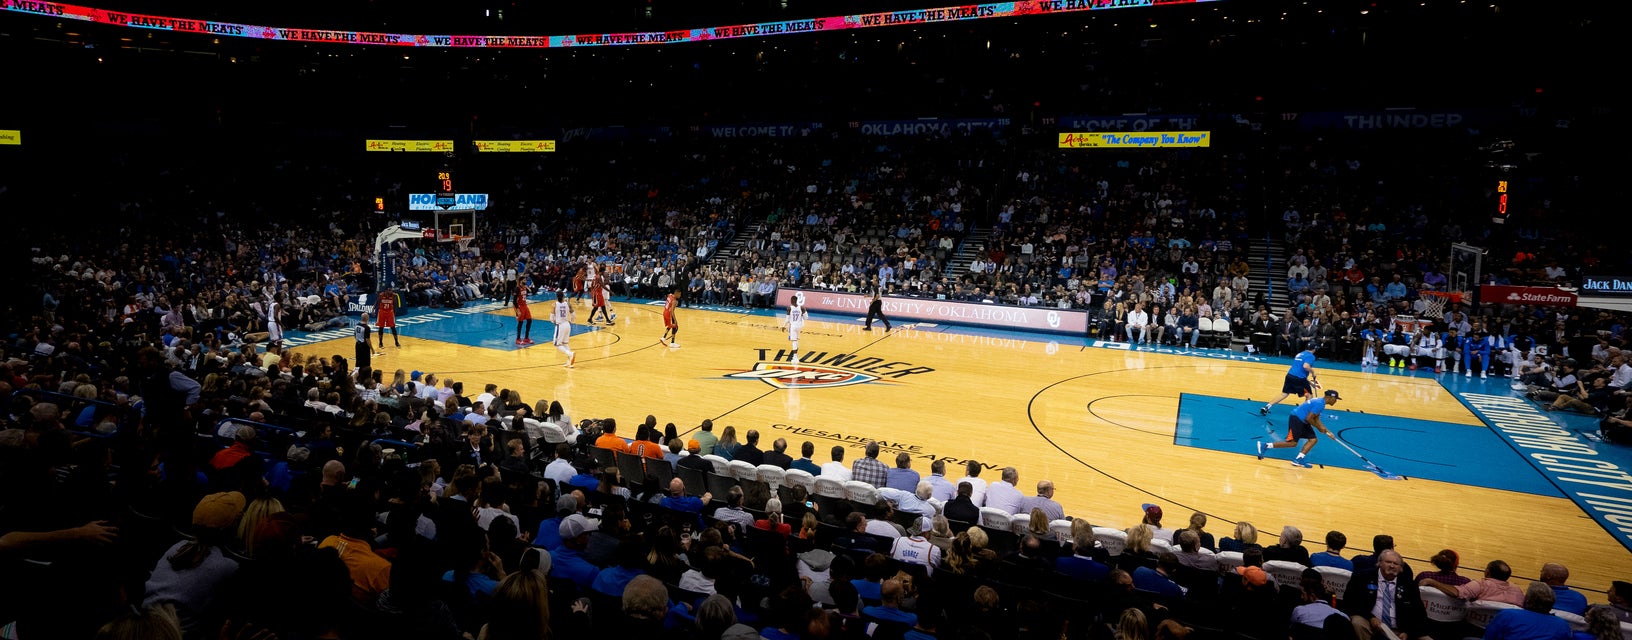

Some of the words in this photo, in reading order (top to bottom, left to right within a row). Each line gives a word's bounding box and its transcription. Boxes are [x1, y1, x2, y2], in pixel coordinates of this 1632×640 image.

[107, 11, 128, 25] WE
[131, 15, 167, 29] HAVE
[167, 19, 195, 31] THE
[199, 21, 243, 35] MEATS
[862, 14, 882, 26] WE
[884, 11, 918, 25] HAVE
[918, 8, 946, 22] THE
[948, 5, 996, 20] MEATS
[279, 29, 299, 40] WE
[301, 31, 333, 41] HAVE
[334, 32, 357, 43] THE
[359, 33, 400, 45] MEATS
[714, 27, 731, 39] WE
[732, 25, 760, 38] HAVE
[761, 23, 783, 34] THE
[785, 19, 825, 33] MEATS
[433, 36, 451, 46] WE
[453, 37, 484, 47] HAVE
[484, 37, 505, 47] THE
[507, 37, 545, 47] MEATS
[577, 35, 594, 46] WE
[596, 34, 625, 45] HAVE
[624, 33, 645, 45] THE
[648, 31, 684, 44] MEATS
[1345, 113, 1463, 129] THUNDER
[1122, 132, 1160, 147] Company
[1160, 131, 1176, 143] You
[443, 180, 452, 192] 19
[411, 194, 487, 205] HOAND
[821, 297, 834, 305] The
[837, 297, 925, 316] UNIVRSITY
[926, 304, 935, 314] of
[938, 303, 1029, 324] OKLAHOMA
[753, 348, 936, 379] THUNDER
[1459, 392, 1599, 457] OKLAHOMA
[771, 422, 923, 453] CHESAPEAKE
[902, 549, 920, 560] GEORGE
